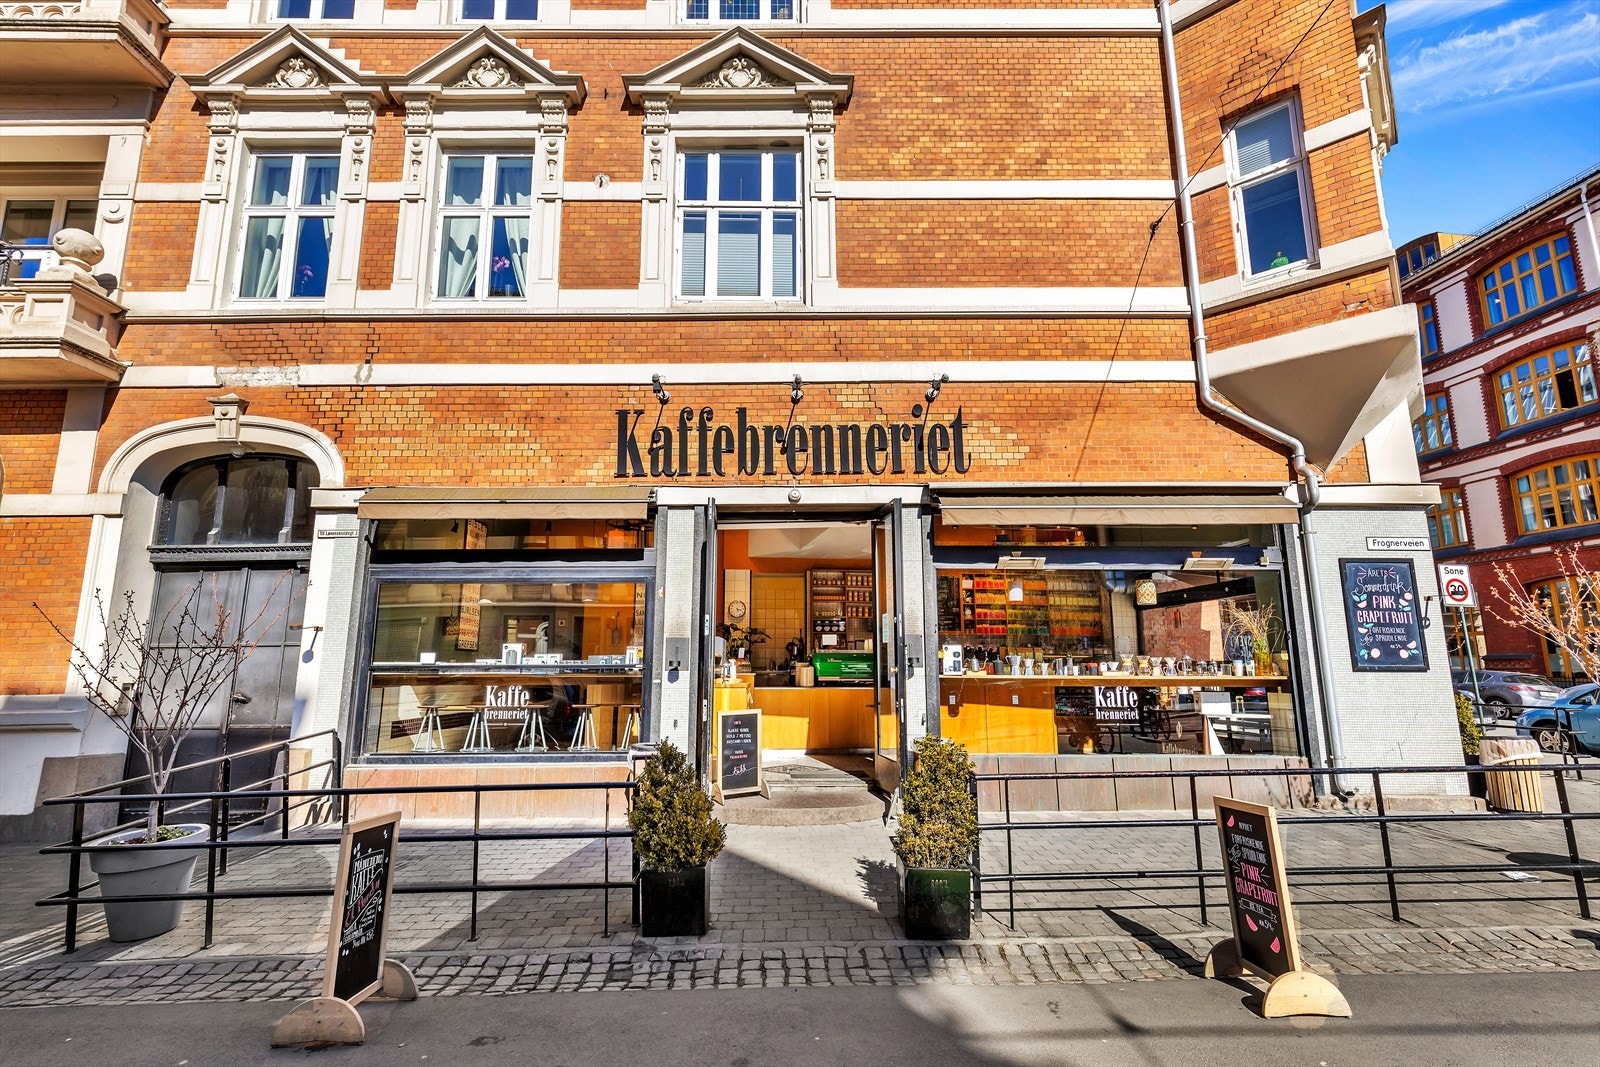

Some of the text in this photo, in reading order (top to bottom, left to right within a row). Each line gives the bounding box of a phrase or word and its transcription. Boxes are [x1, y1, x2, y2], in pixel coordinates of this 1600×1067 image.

[614, 404, 972, 477] Kaffebrenneriet
[1372, 539, 1425, 549] Frognerveien
[1367, 567, 1388, 578] ÅRETS
[1444, 566, 1464, 575] Sone
[1372, 595, 1396, 609] PINK
[1357, 610, 1413, 625] GRAPEFRUIT
[485, 685, 530, 708] Kaffe
[1093, 685, 1139, 708] Kaffe
[484, 708, 530, 720] brenneriet
[1095, 708, 1140, 720] brenneriet
[353, 854, 383, 874] MÅNEDENS
[1240, 861, 1262, 883] PINK
[349, 864, 377, 906] KAFFE
[1234, 876, 1278, 907] GRAPEFRUIT
